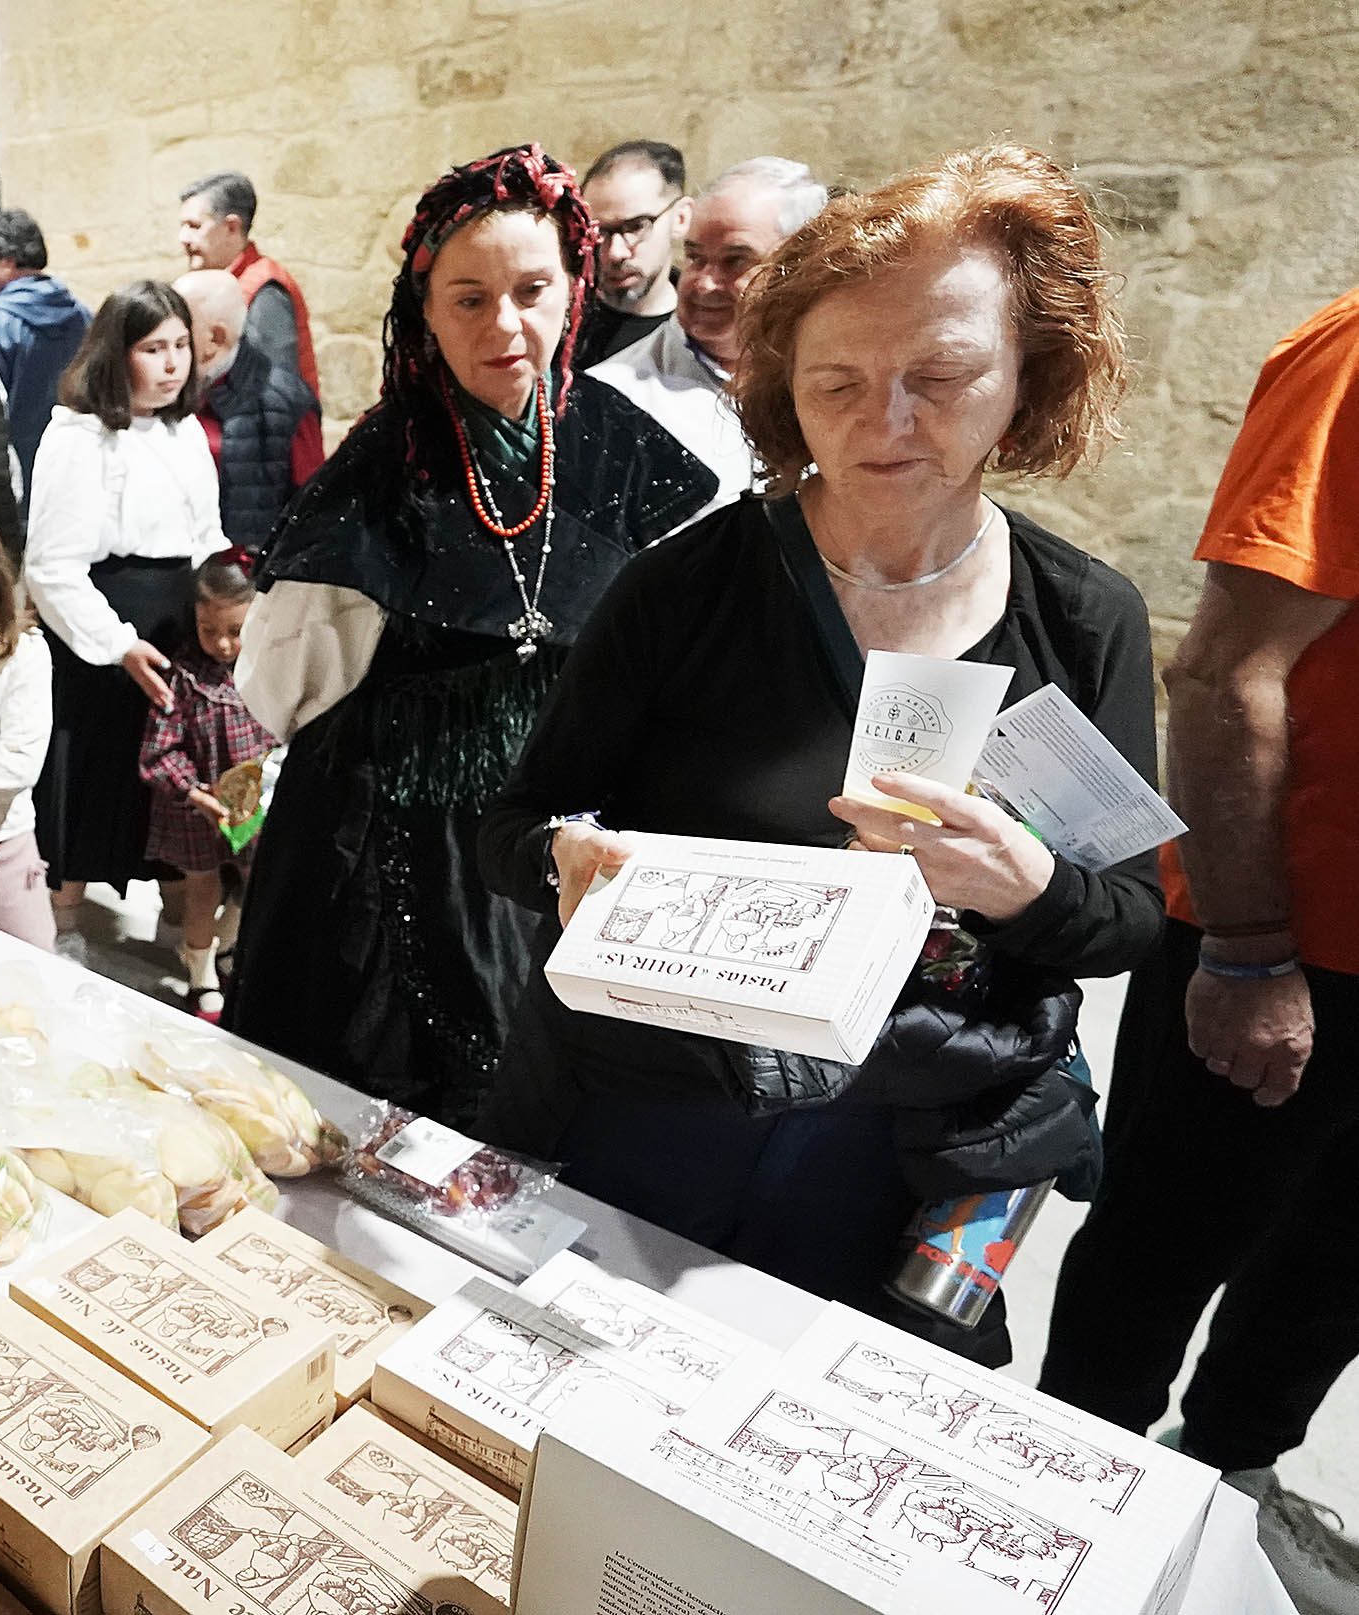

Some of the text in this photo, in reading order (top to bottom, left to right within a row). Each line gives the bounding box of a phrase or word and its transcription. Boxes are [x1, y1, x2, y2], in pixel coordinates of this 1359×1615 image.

[716, 966, 789, 994] Pastas
[101, 1317, 126, 1338] de
[128, 1336, 194, 1386] Pastas
[602, 1570, 645, 1598] Sotomayor
[645, 1596, 656, 1605] en
[603, 1562, 637, 1585] Guardia
[604, 1554, 635, 1575] procede
[636, 1572, 649, 1583] del
[649, 1580, 696, 1610] Monasterio
[615, 1550, 626, 1560] La
[626, 1557, 674, 1588] Comunidad
[674, 1585, 685, 1595] de
[629, 1596, 640, 1605] en
